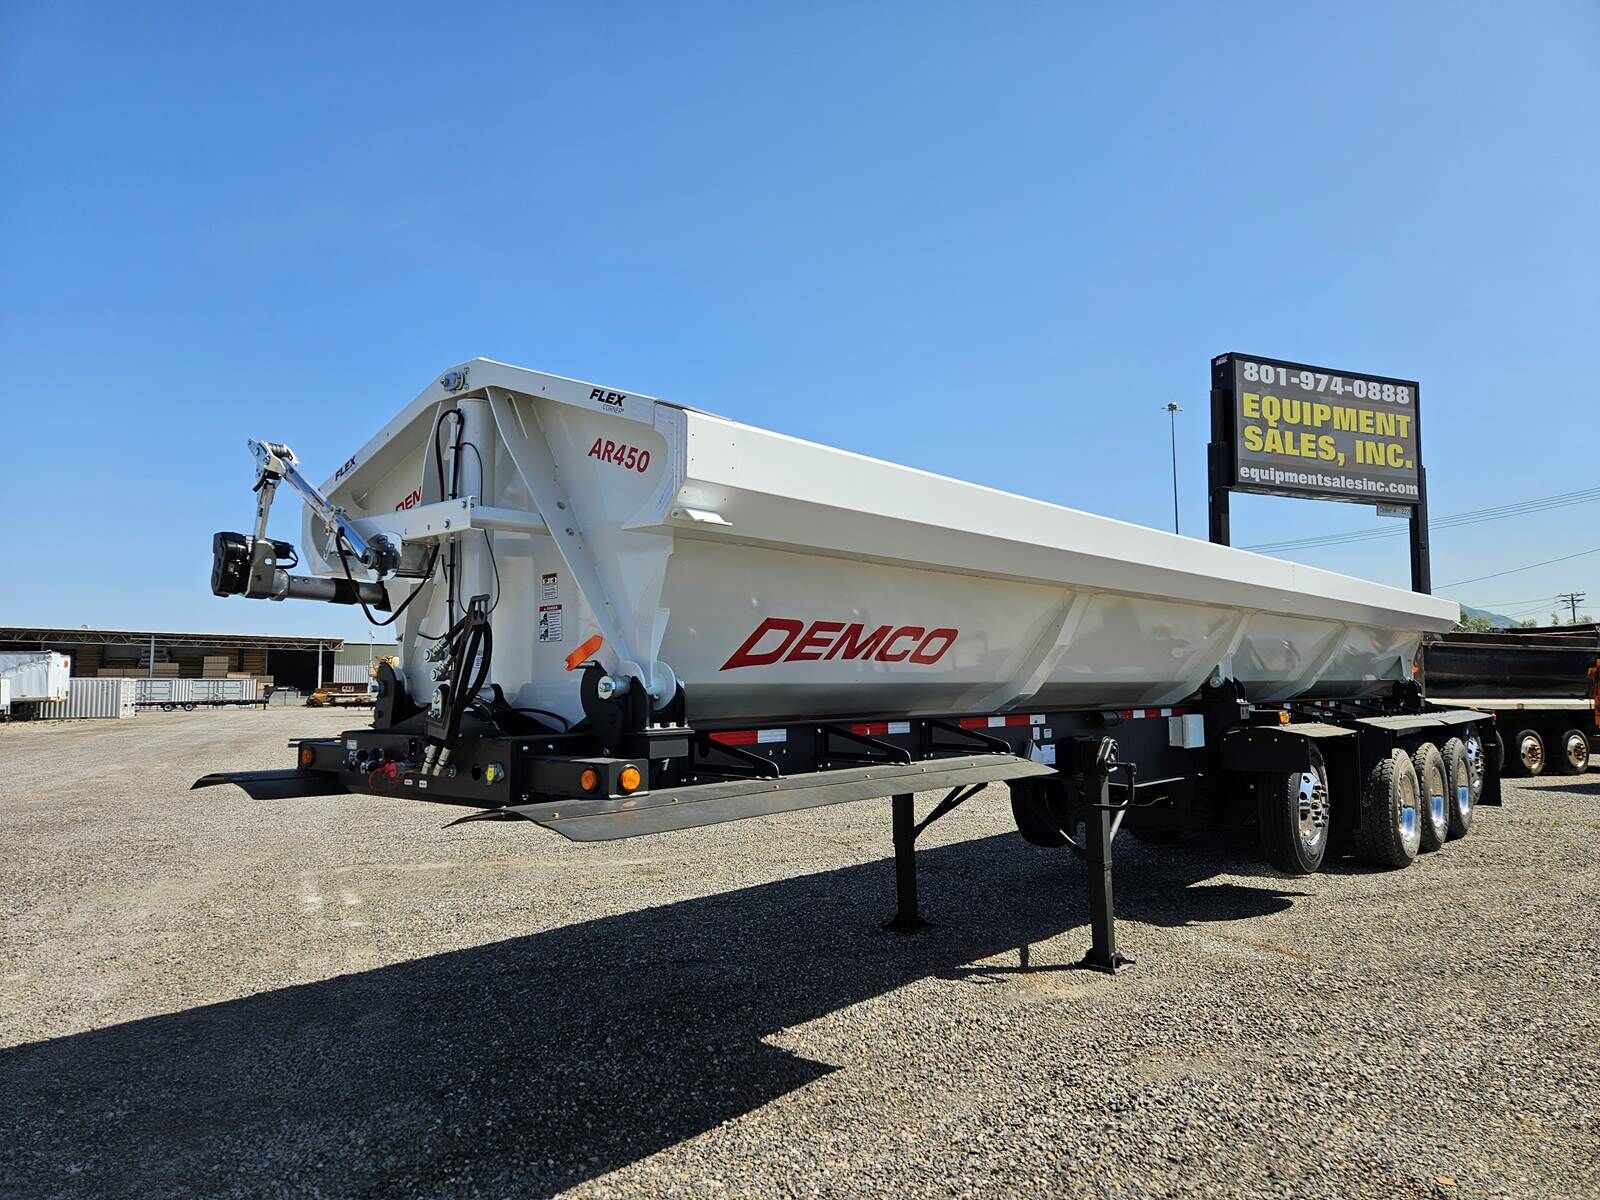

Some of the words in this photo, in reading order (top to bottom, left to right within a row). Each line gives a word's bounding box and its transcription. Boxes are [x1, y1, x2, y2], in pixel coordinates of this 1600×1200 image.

[589, 388, 627, 407] FLEX
[1243, 362, 1410, 404] 801-974-0888
[1242, 392, 1412, 439] EQUIPMENT
[587, 437, 651, 473] AR450
[1244, 425, 1346, 467] SALES,
[1355, 439, 1414, 470] INC.
[335, 455, 357, 481] FLEX
[1240, 466, 1418, 496] equipmentsalesinc.com
[718, 617, 959, 672] DEMCO
